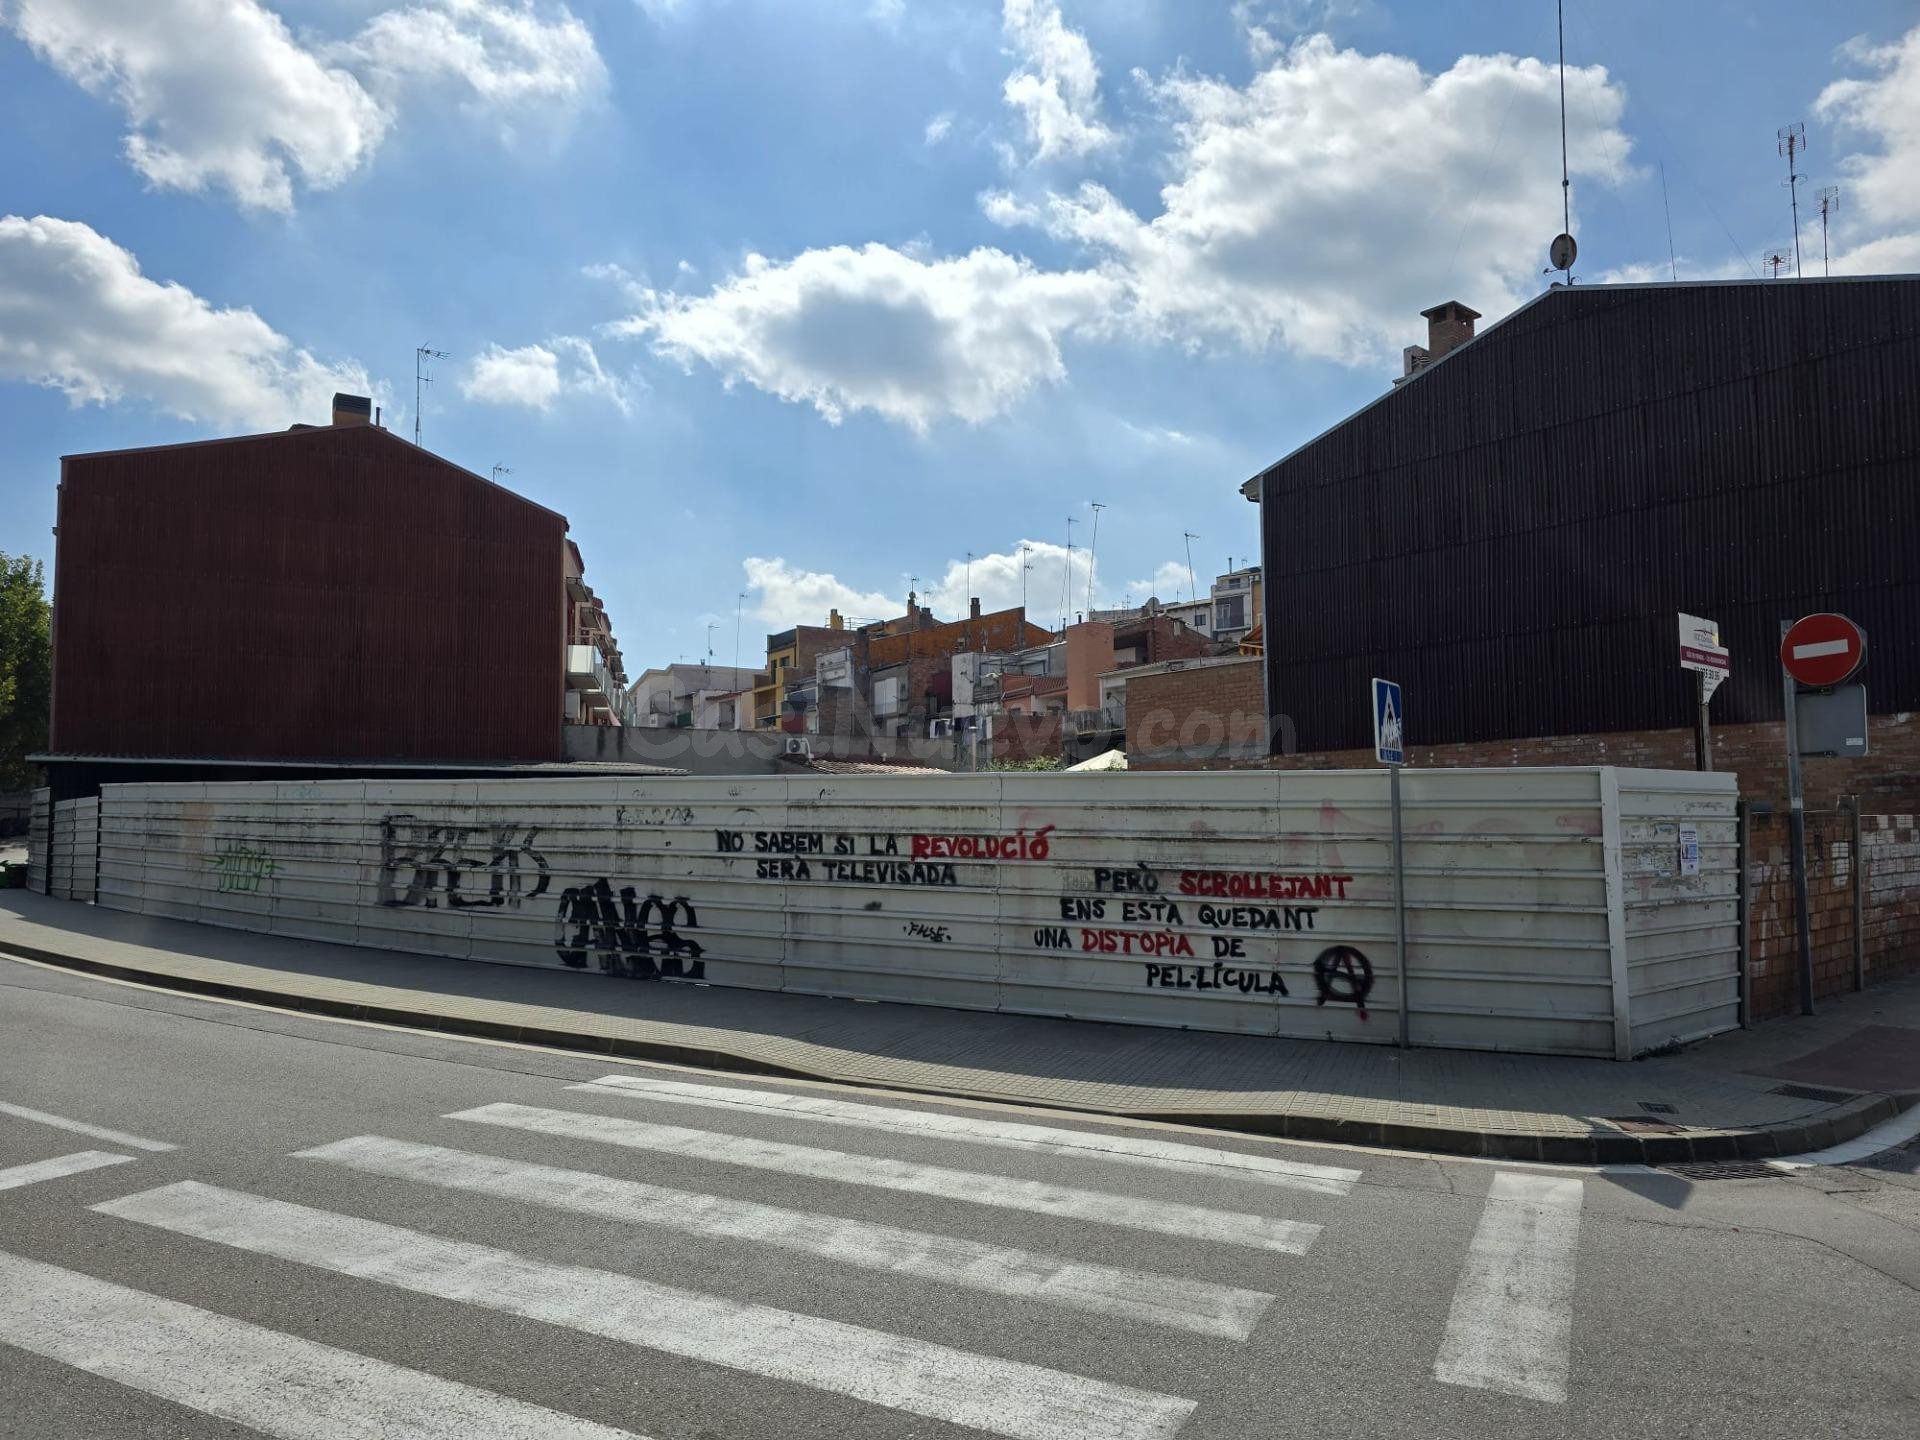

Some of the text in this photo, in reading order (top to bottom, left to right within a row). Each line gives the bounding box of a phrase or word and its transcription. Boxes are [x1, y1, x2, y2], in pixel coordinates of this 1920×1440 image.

[715, 824, 1055, 860] NO SABEM SI LA REVOLUCIÓ
[756, 855, 957, 884] SERÀ TELEVISADA
[1095, 861, 1353, 898] PERÒ SCROLLEJANT
[1060, 896, 1319, 930] ENS ESTÀ QUEDANT
[1034, 928, 1072, 948] UNA
[1212, 936, 1246, 958] DE
